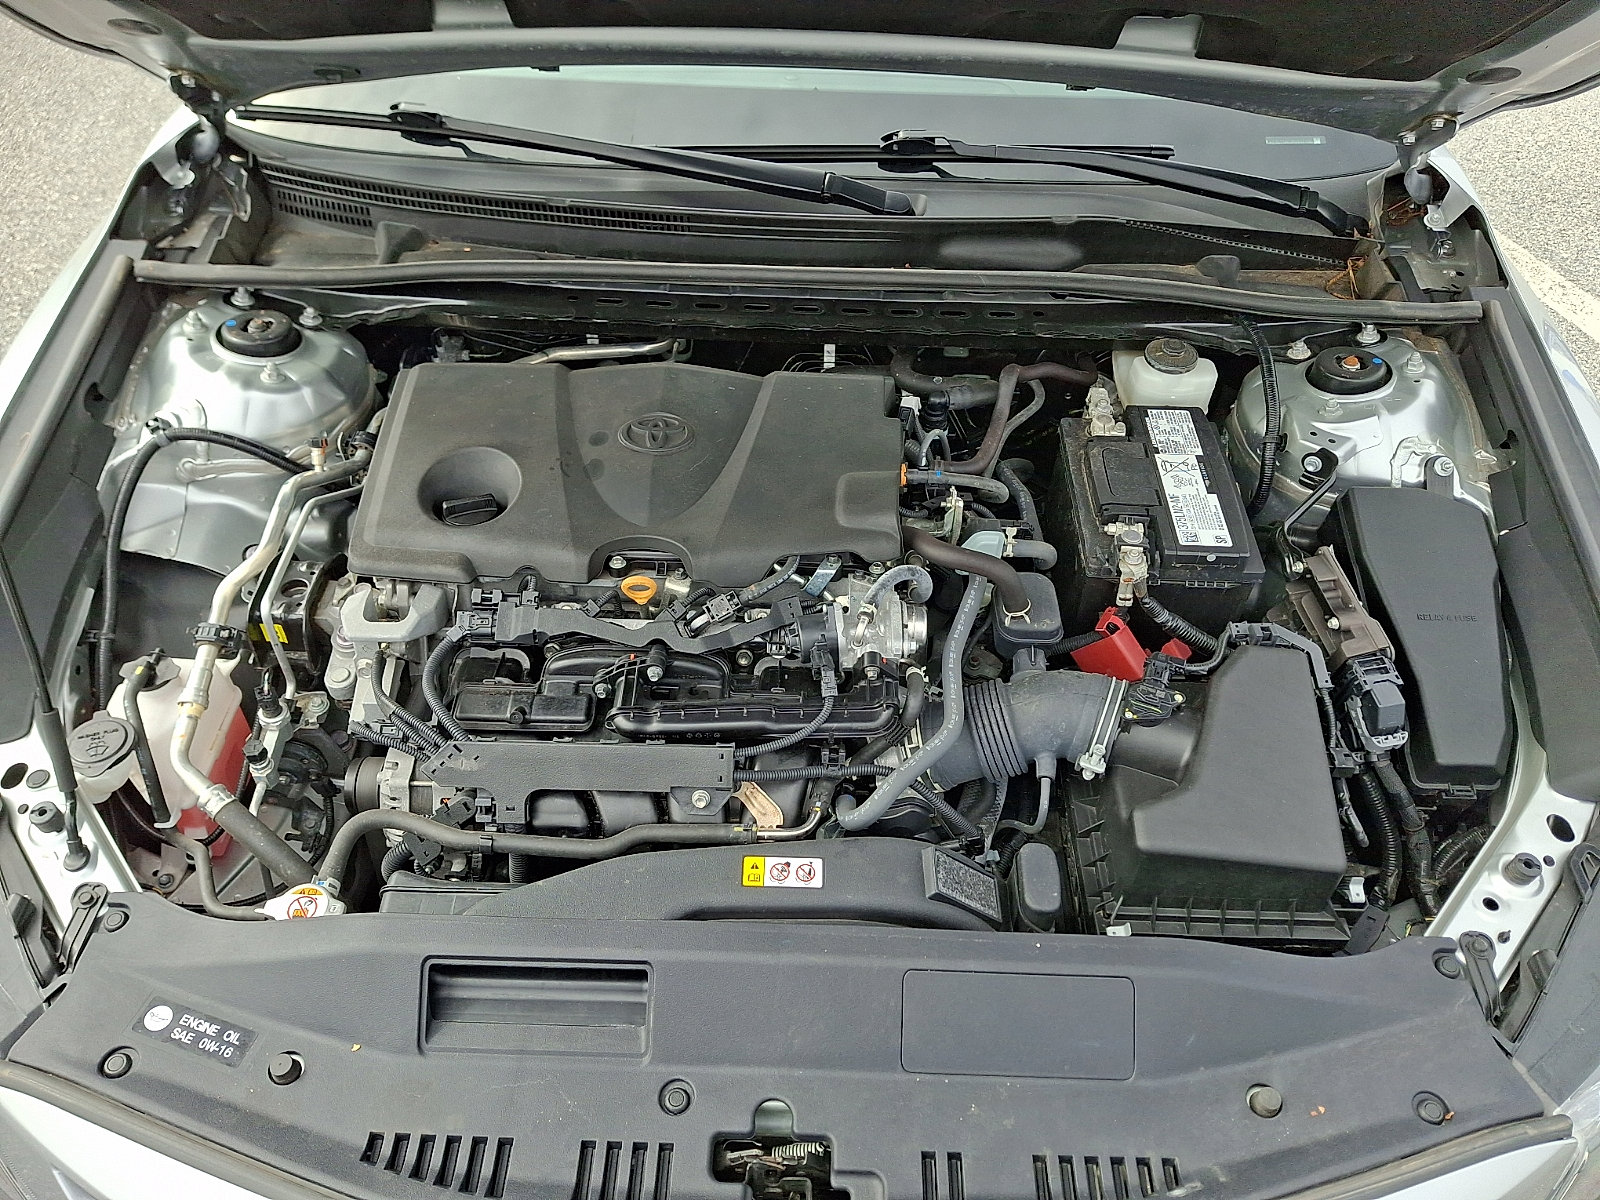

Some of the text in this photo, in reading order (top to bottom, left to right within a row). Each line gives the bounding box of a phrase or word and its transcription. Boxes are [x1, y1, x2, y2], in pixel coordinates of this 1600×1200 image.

[170, 1027, 234, 1058] SAE 0W-16
[178, 1013, 241, 1045] ENGINE OIL
